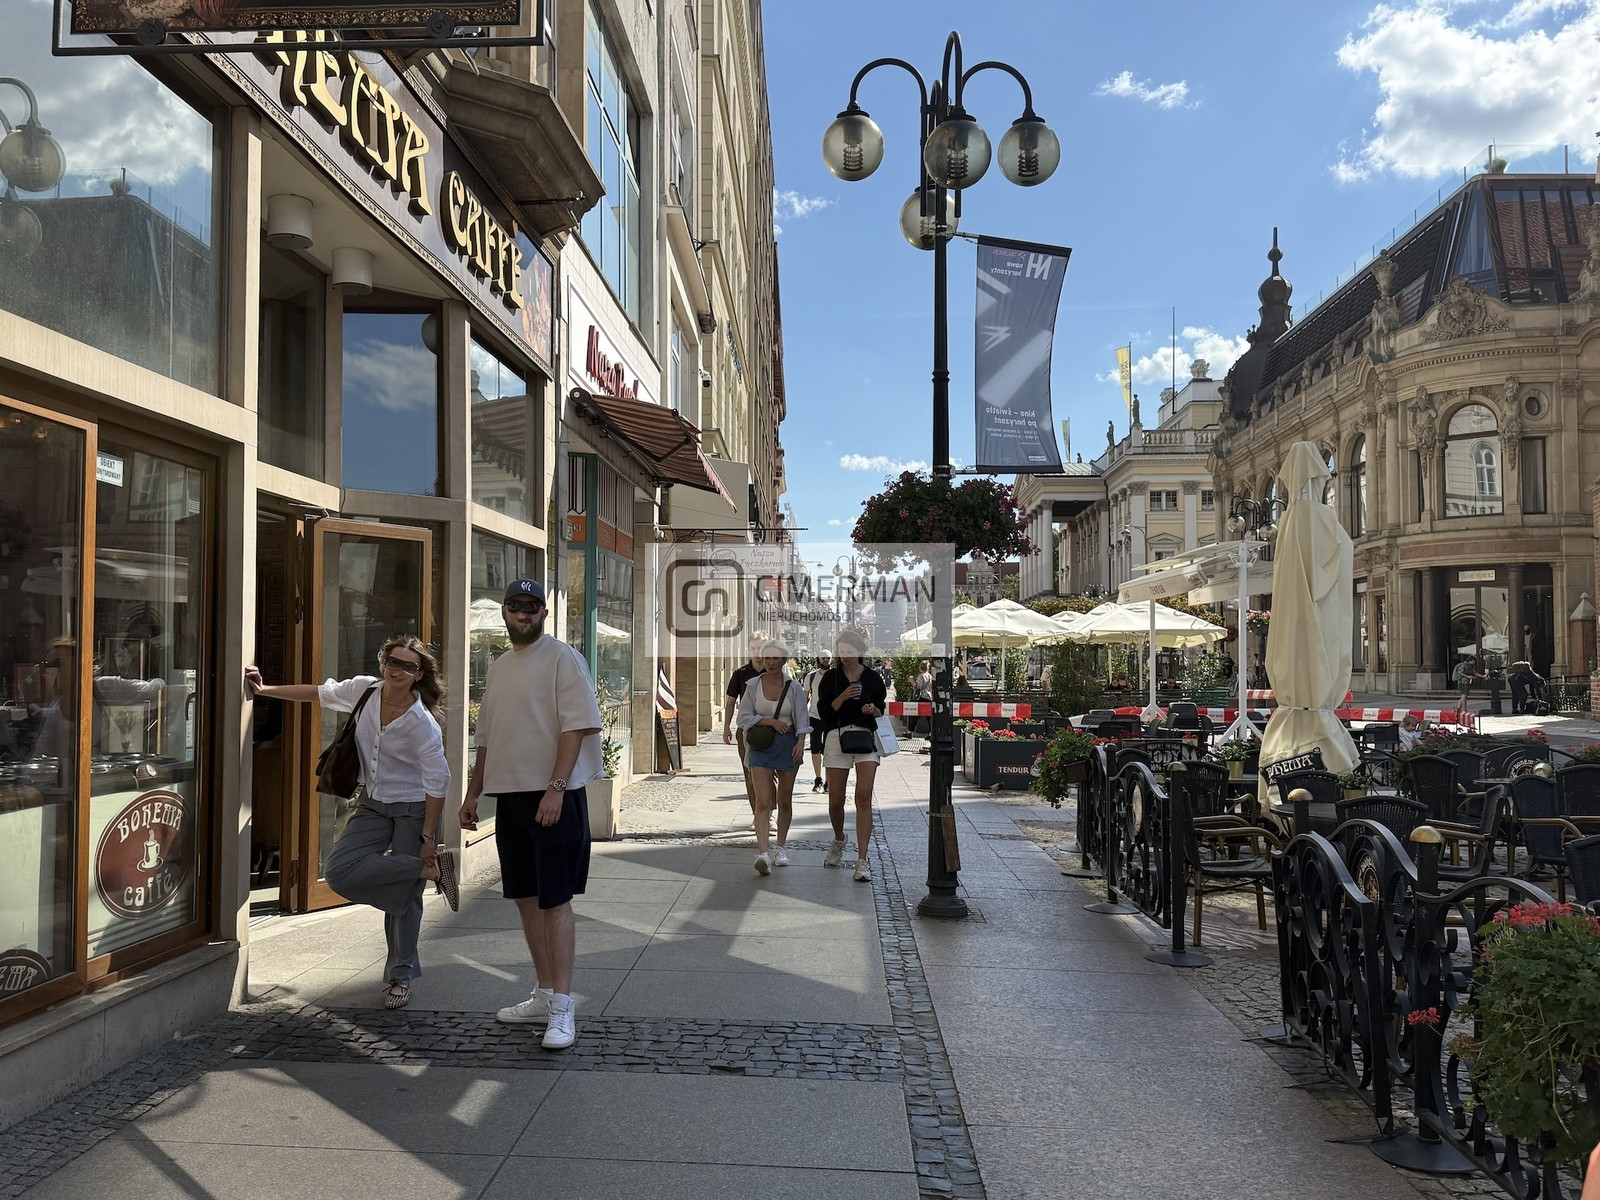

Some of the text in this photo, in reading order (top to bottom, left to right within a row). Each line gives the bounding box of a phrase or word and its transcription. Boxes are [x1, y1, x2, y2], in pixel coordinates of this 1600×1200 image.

[100, 457, 116, 470] OBIEKT
[97, 467, 121, 480] ONITOROWANY
[750, 548, 775, 558] Nasza
[998, 766, 1030, 774] TENDUR
[117, 802, 183, 843] BOHEMA
